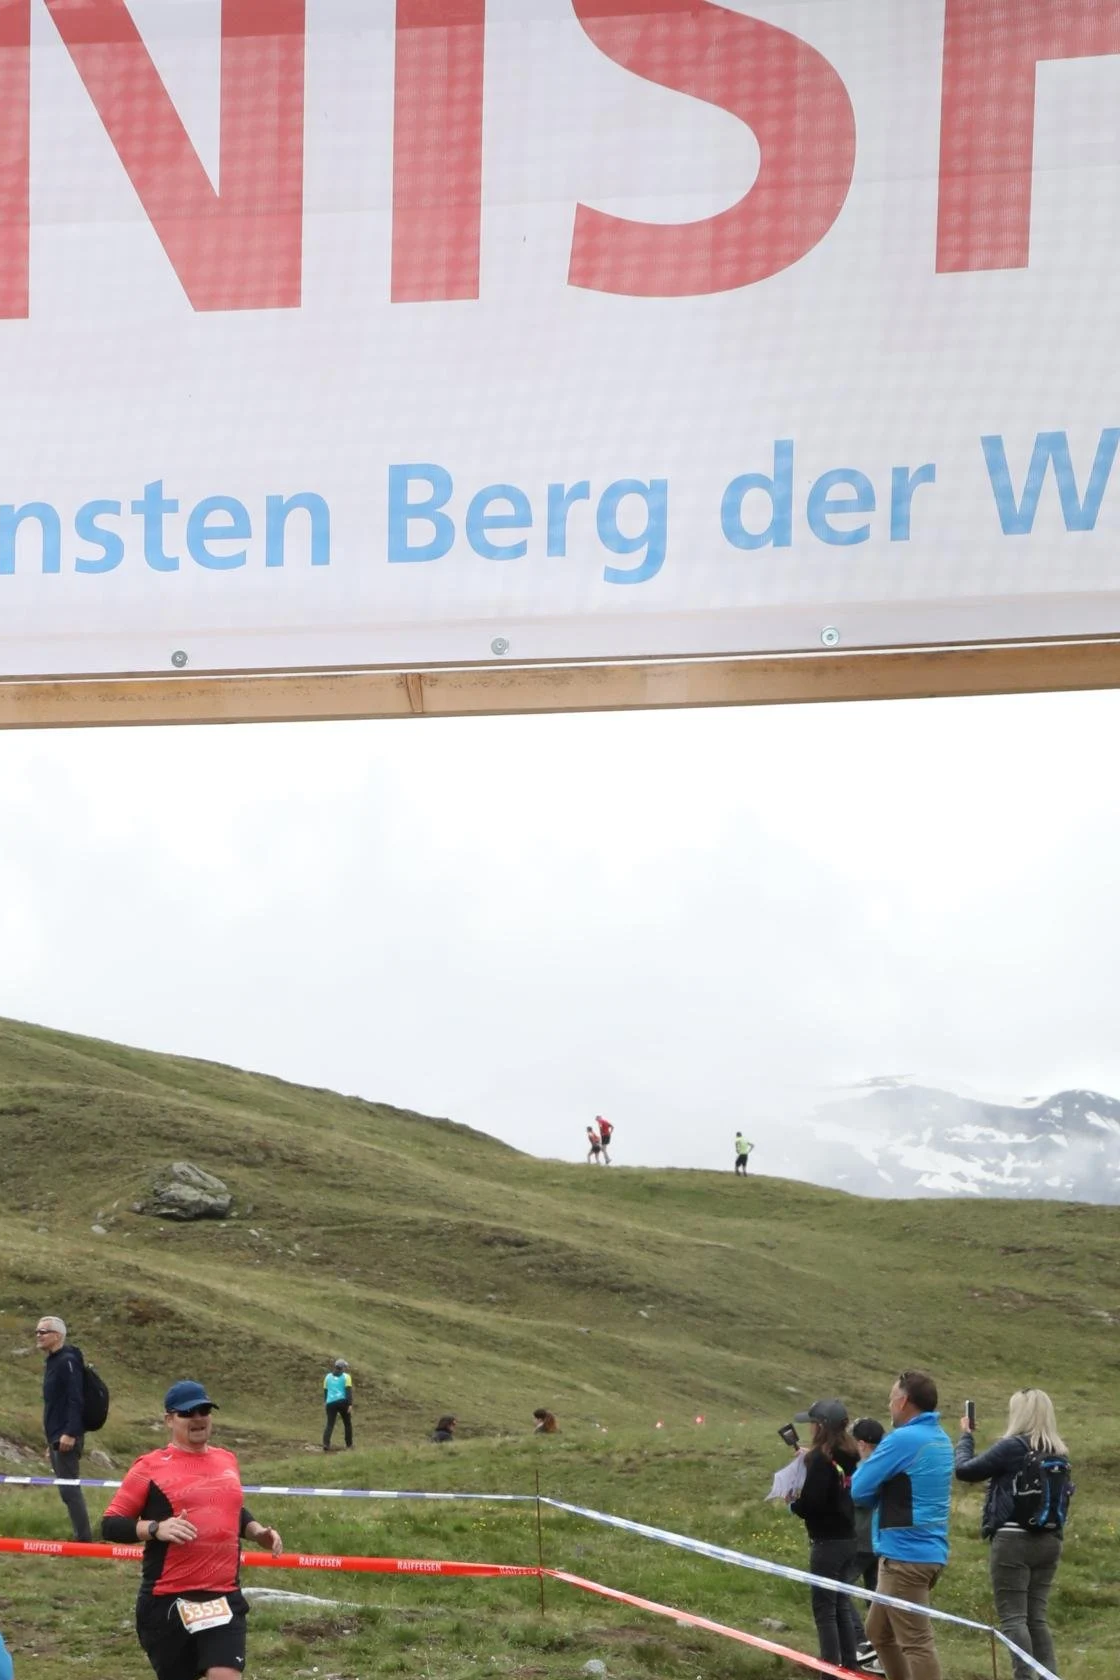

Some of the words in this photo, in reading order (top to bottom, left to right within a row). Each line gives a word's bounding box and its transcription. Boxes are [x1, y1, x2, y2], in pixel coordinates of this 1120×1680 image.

[387, 462, 669, 584] Berg
[720, 439, 936, 550] der
[23, 1541, 63, 1553] RAIFFEISEN
[112, 1547, 143, 1557] RAIFFEIS
[298, 1556, 342, 1568] RAIFFEISEN
[397, 1560, 442, 1571] RAIFFEISEN
